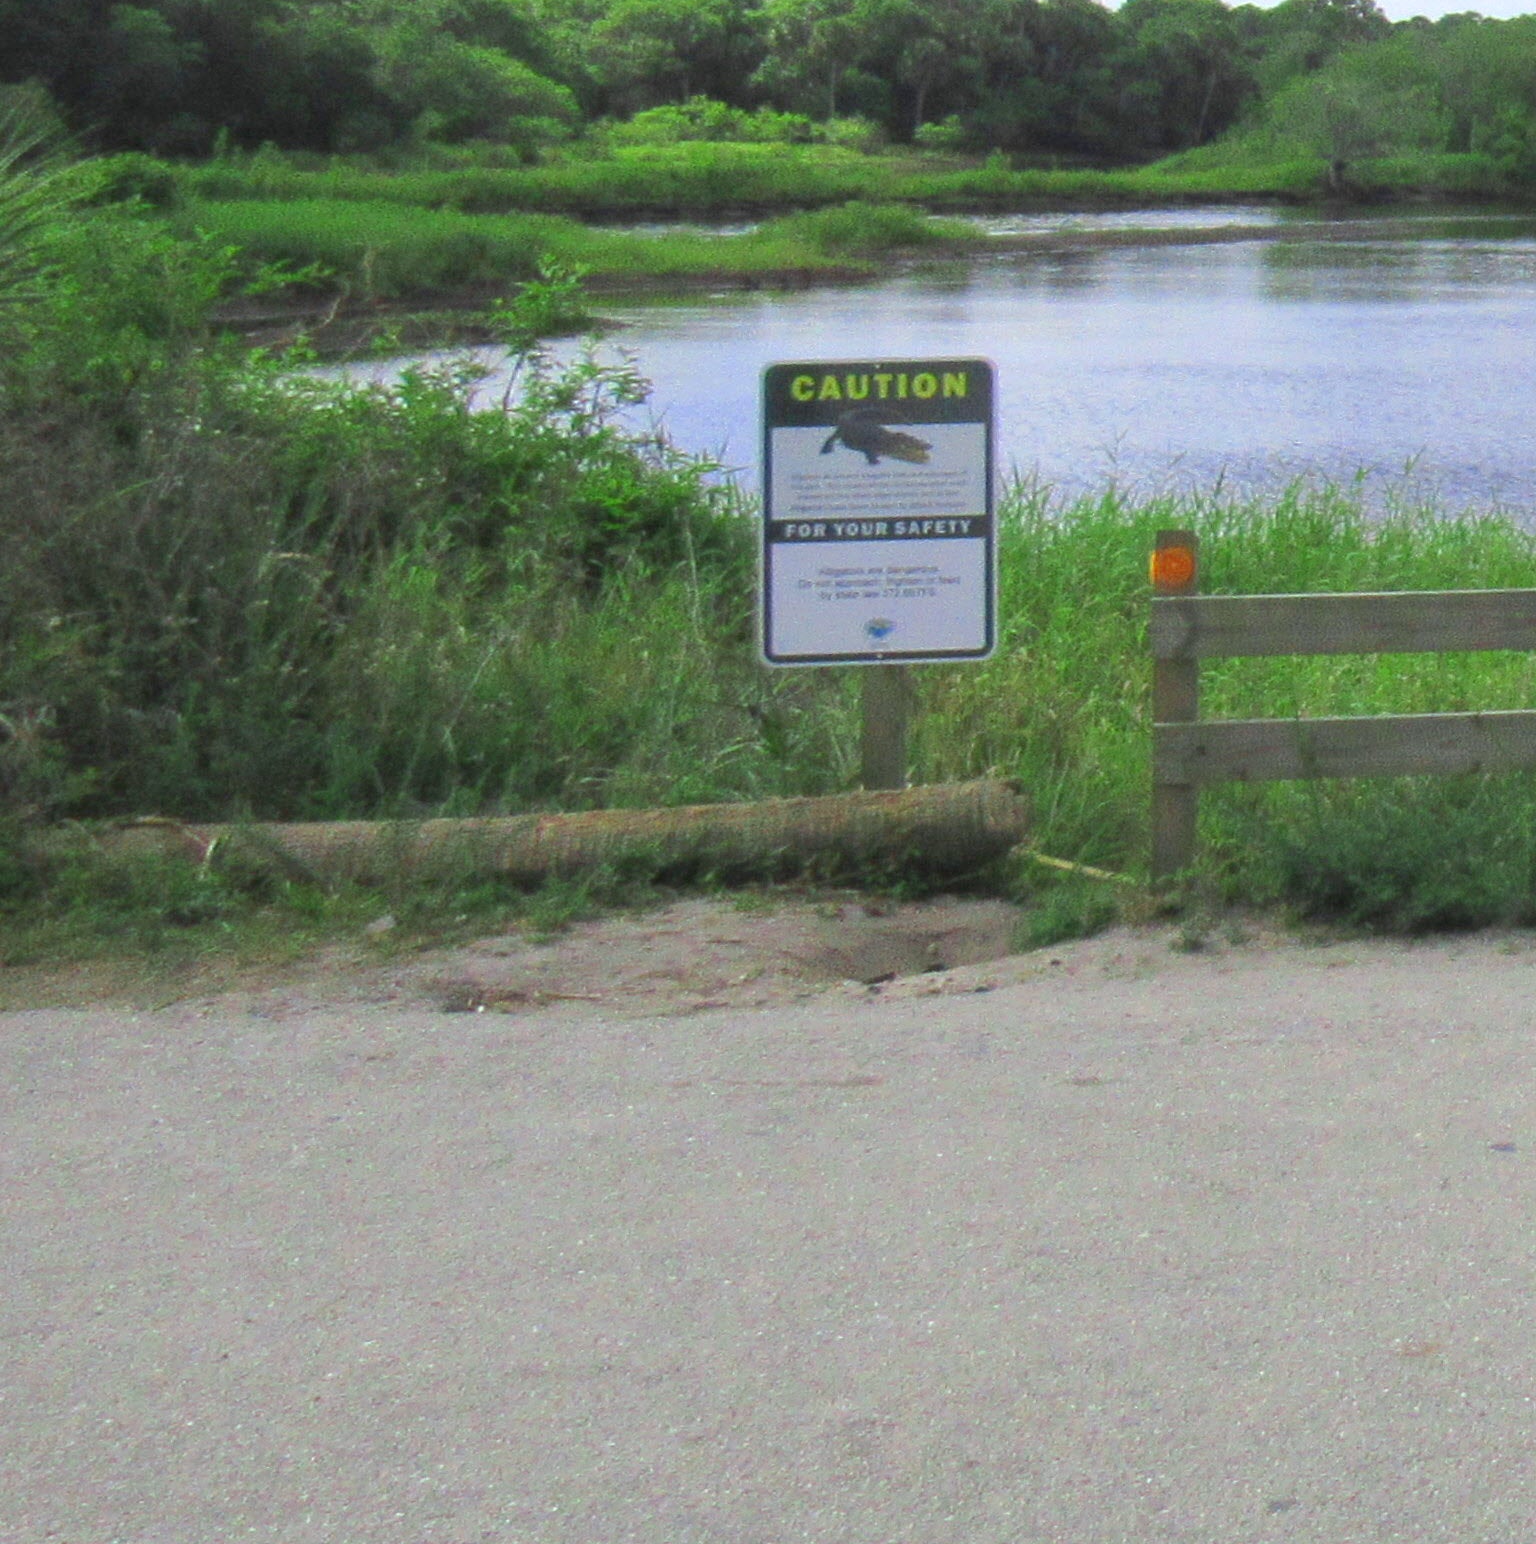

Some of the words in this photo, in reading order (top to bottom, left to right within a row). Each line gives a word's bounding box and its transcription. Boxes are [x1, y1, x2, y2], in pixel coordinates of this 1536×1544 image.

[791, 372, 968, 401] CAUTION
[784, 522, 827, 538] FOR
[834, 521, 888, 537] YOUR
[894, 519, 972, 536] SAFETY
